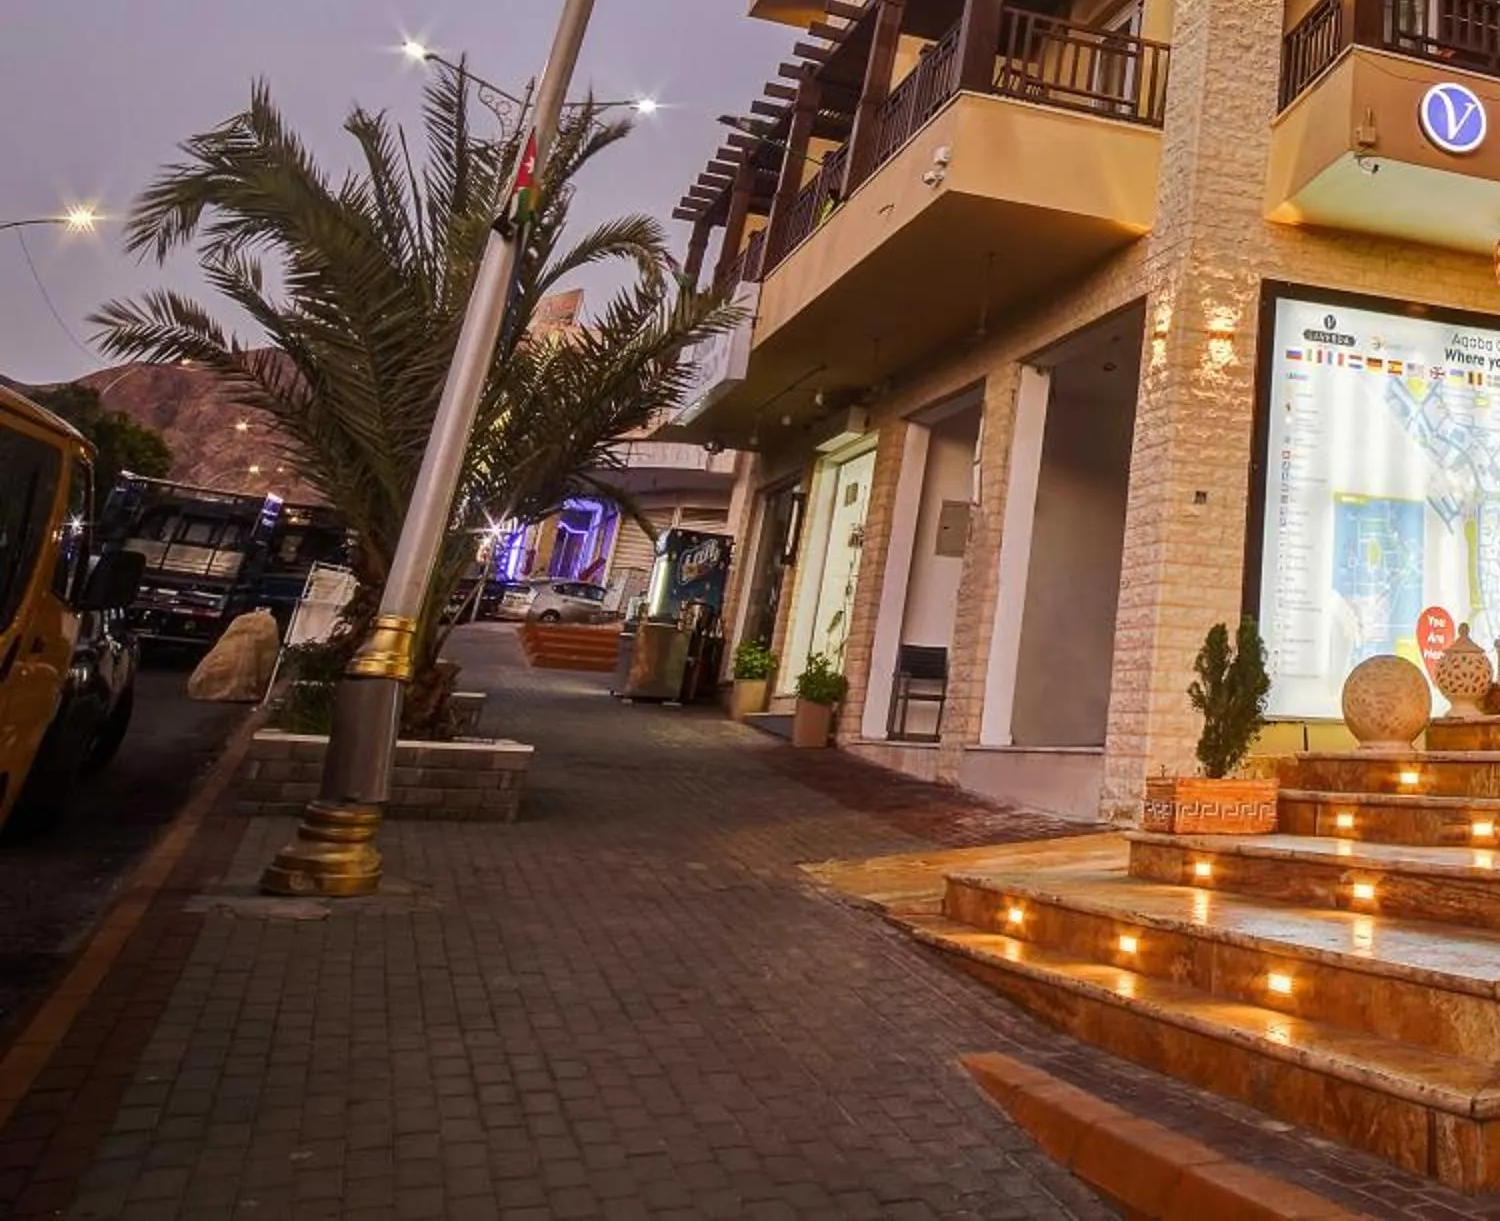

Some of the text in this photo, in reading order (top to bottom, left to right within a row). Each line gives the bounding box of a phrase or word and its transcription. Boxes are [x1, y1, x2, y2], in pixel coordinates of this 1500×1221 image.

[1432, 89, 1477, 141] V
[1451, 333, 1493, 351] Aqaba
[1444, 347, 1486, 366] Where
[1426, 615, 1447, 628] You
[1427, 632, 1446, 645] Are
[1423, 648, 1446, 661] Her
